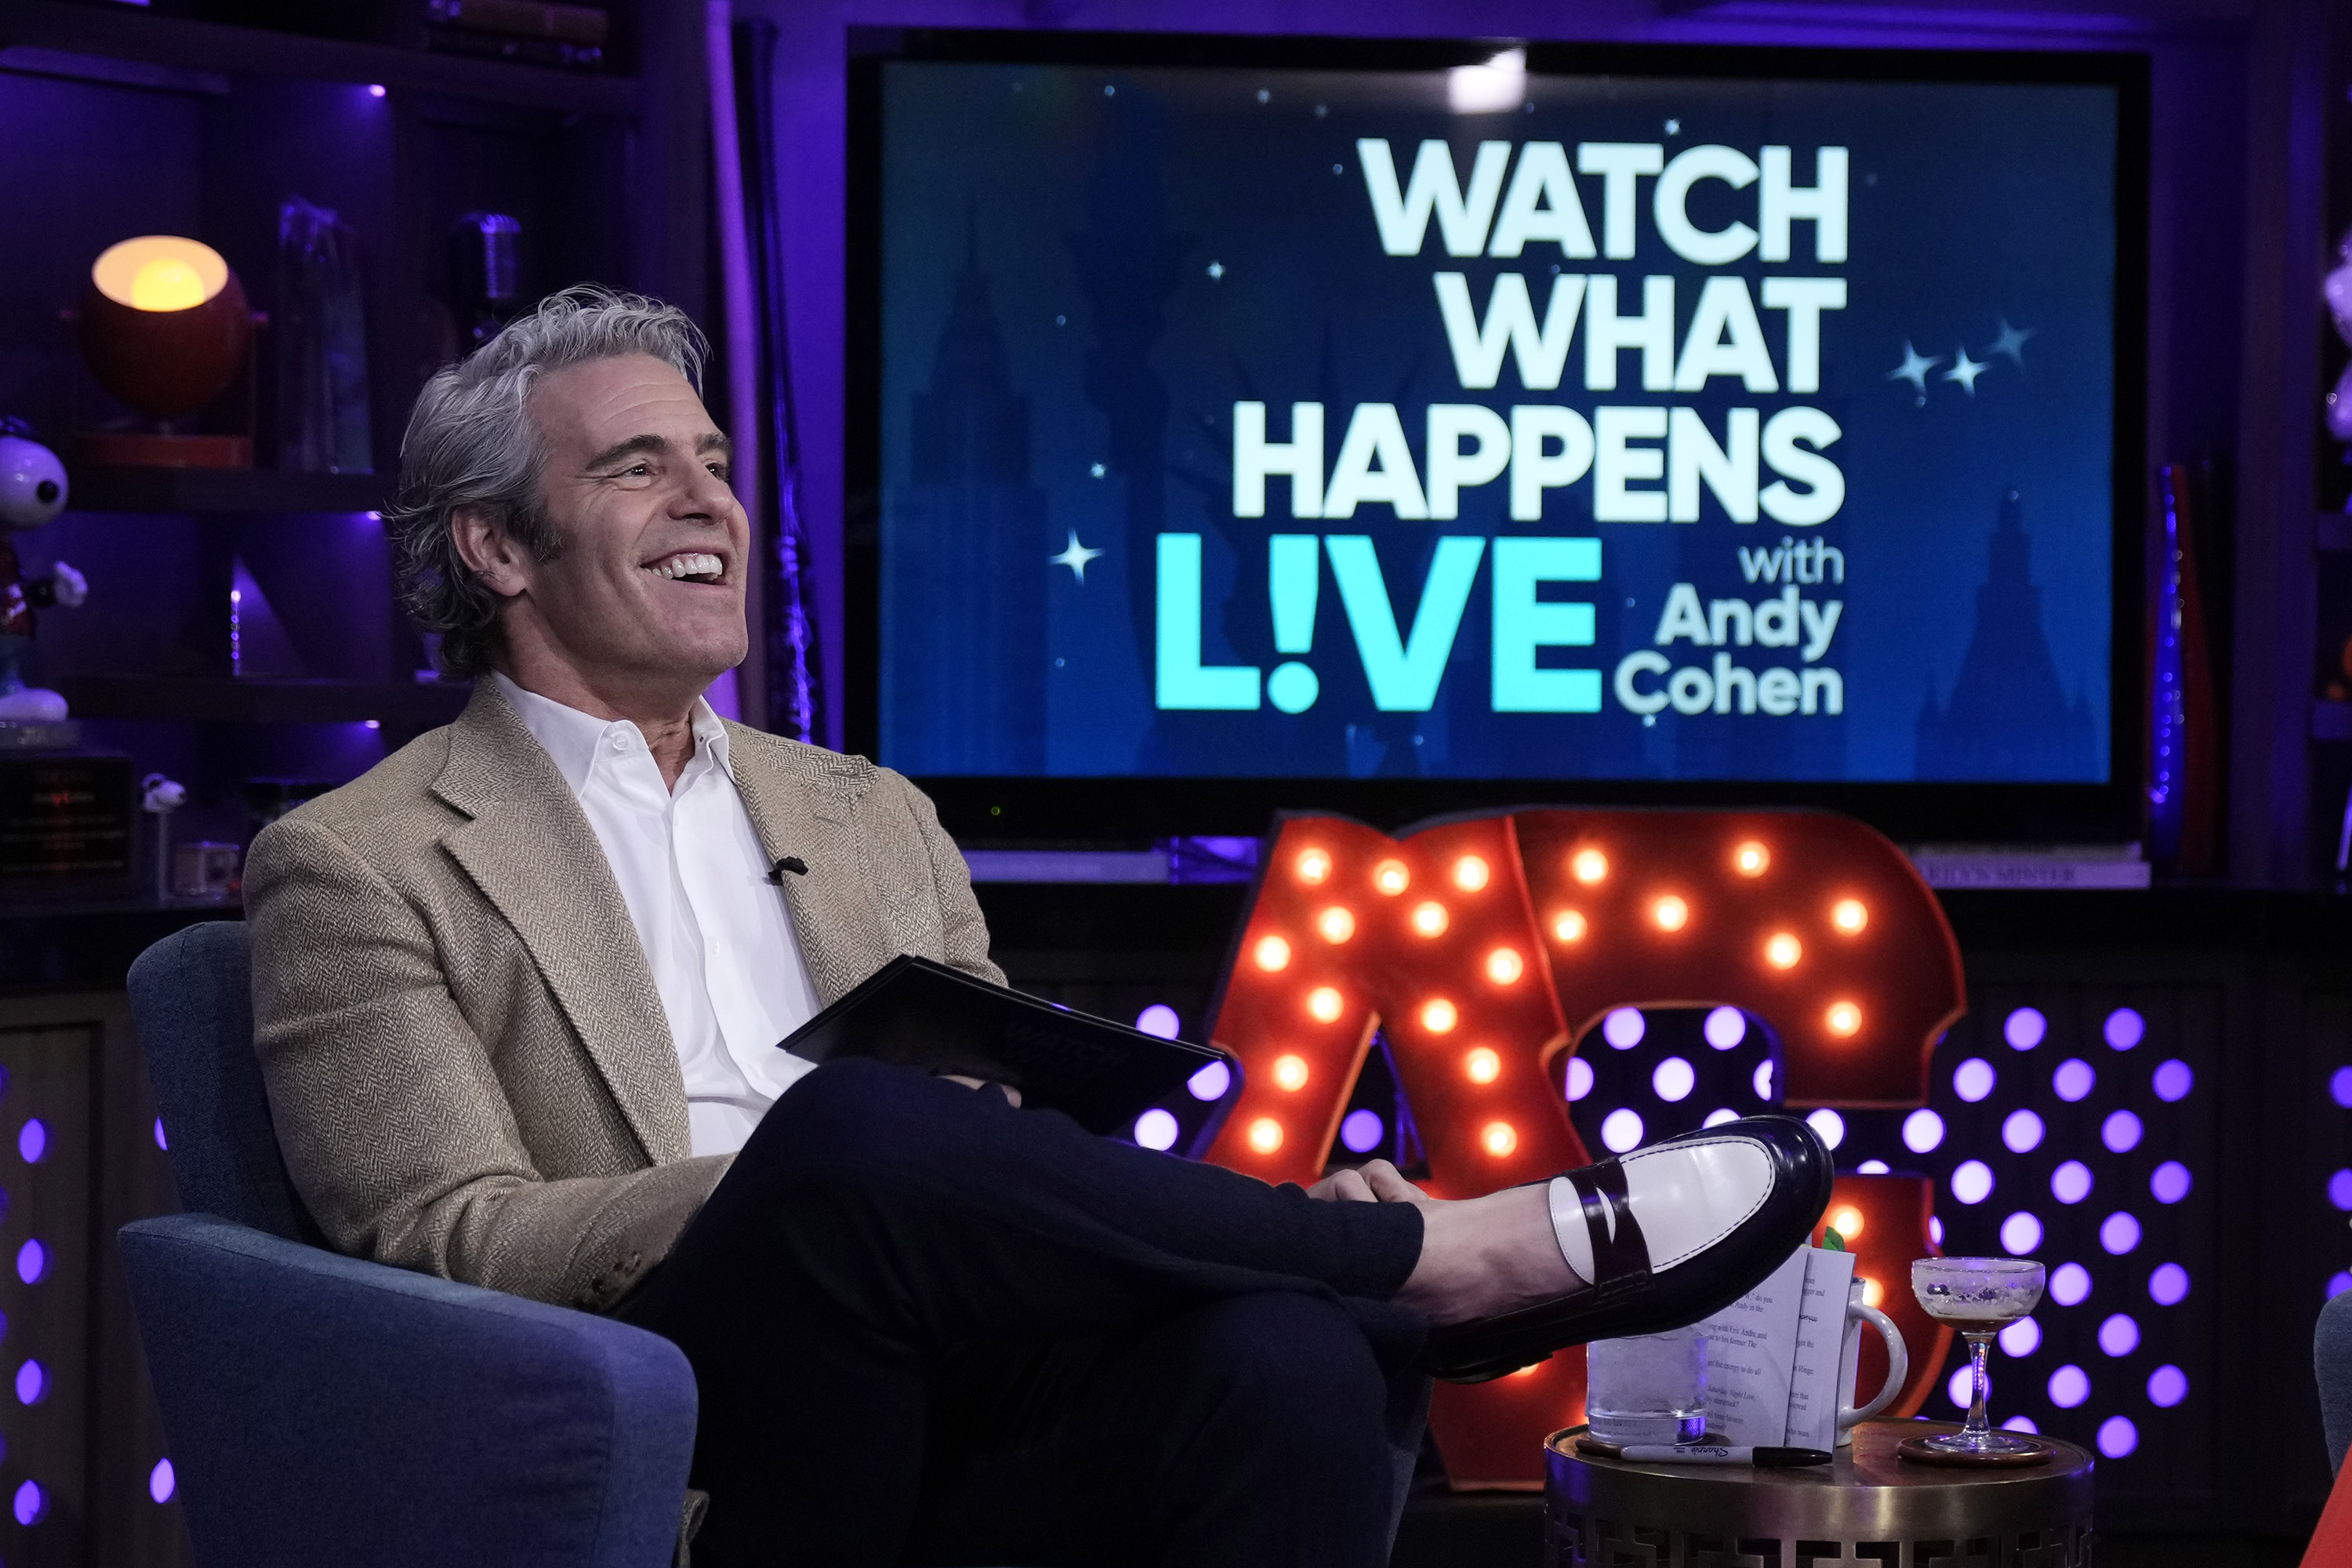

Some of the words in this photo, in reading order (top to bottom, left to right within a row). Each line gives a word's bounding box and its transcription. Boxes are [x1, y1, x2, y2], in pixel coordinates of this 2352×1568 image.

[1356, 138, 1849, 264] WATCH
[1433, 272, 1847, 393] WHAT
[1232, 401, 1846, 526] HAPPENS
[1740, 537, 1844, 584] with
[1156, 533, 1602, 713] L!VE
[1655, 583, 1843, 660] Andy
[1613, 651, 1844, 715] Cohen
[1734, 1301, 1748, 1312] Andy
[1691, 1446, 1729, 1457] Sharpie
